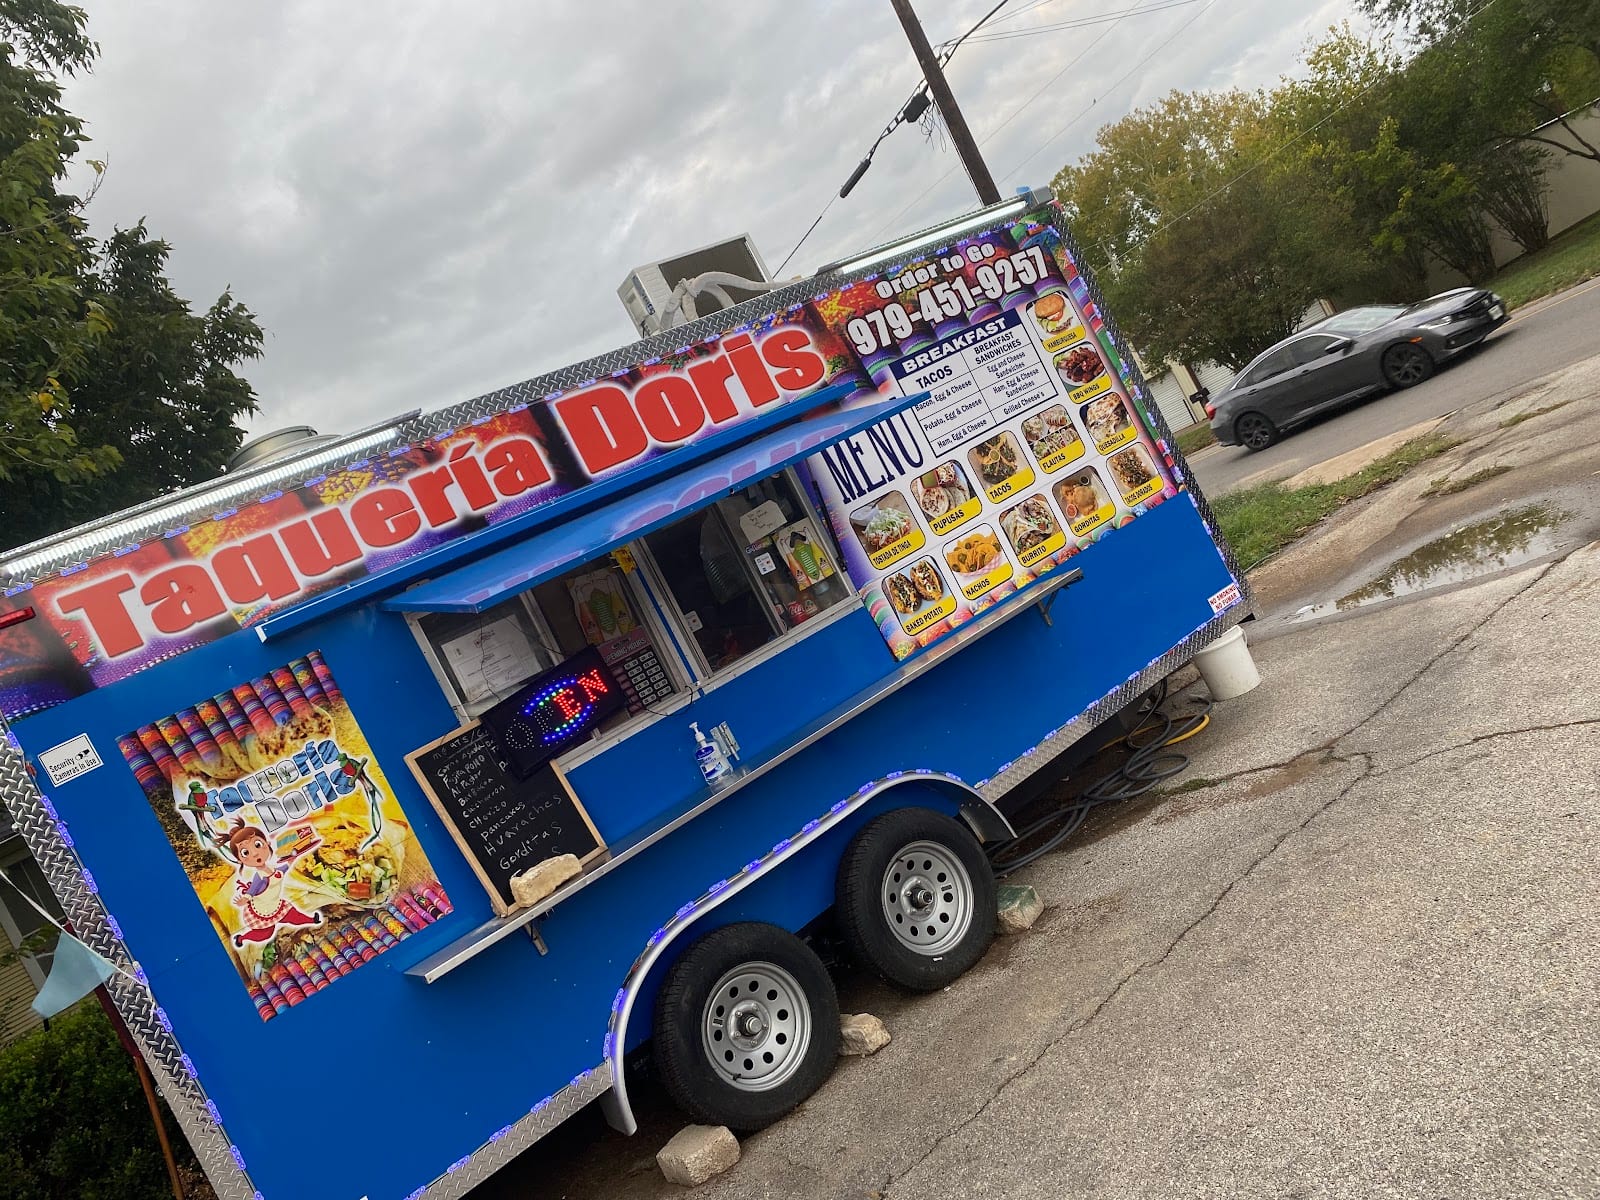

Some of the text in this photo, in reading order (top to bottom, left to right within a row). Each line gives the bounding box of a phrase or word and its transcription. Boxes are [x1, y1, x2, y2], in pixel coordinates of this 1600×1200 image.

[876, 243, 996, 299] Order to Go
[847, 245, 1049, 355] 979-451-9257
[901, 317, 1007, 374] BREAKFAST
[974, 331, 1014, 354] BREAKFAST
[975, 338, 1022, 364] SANDWICHES
[987, 364, 998, 373] Egg
[1006, 352, 1026, 364] Cheese
[996, 362, 1025, 379] Sandwiches
[916, 365, 952, 390] TACOS
[993, 368, 1039, 394] Ham, Egg & Cheese
[1006, 380, 1035, 398] Sandwiches
[915, 398, 935, 412] Bacon,
[934, 392, 946, 402] Egg
[950, 380, 972, 394] Cheese
[1073, 383, 1100, 400] BBQ WINGS
[945, 411, 957, 421] Egg
[961, 398, 982, 412] Cheese
[1004, 401, 1021, 415] Grilled
[937, 419, 987, 449] Ham, Egg & Cheese
[1098, 433, 1126, 452] QUESADILLA
[820, 410, 924, 505] MENU
[1042, 453, 1066, 470] FLAUTAS
[57, 327, 827, 658] Taquería Doris
[990, 483, 1012, 499] TACOS
[933, 509, 965, 532] PUPUSAS
[1074, 514, 1100, 533] GORDITAS
[873, 540, 912, 566] TOSTADA DE TINGA
[1021, 545, 1047, 564] BURRITO
[966, 578, 990, 597] NACHOS
[906, 606, 943, 633] BAKED POTATO
[505, 669, 608, 749] OPEN
[49, 758, 75, 773] Security
[54, 766, 80, 781] Cameras
[255, 768, 356, 833] Doris
